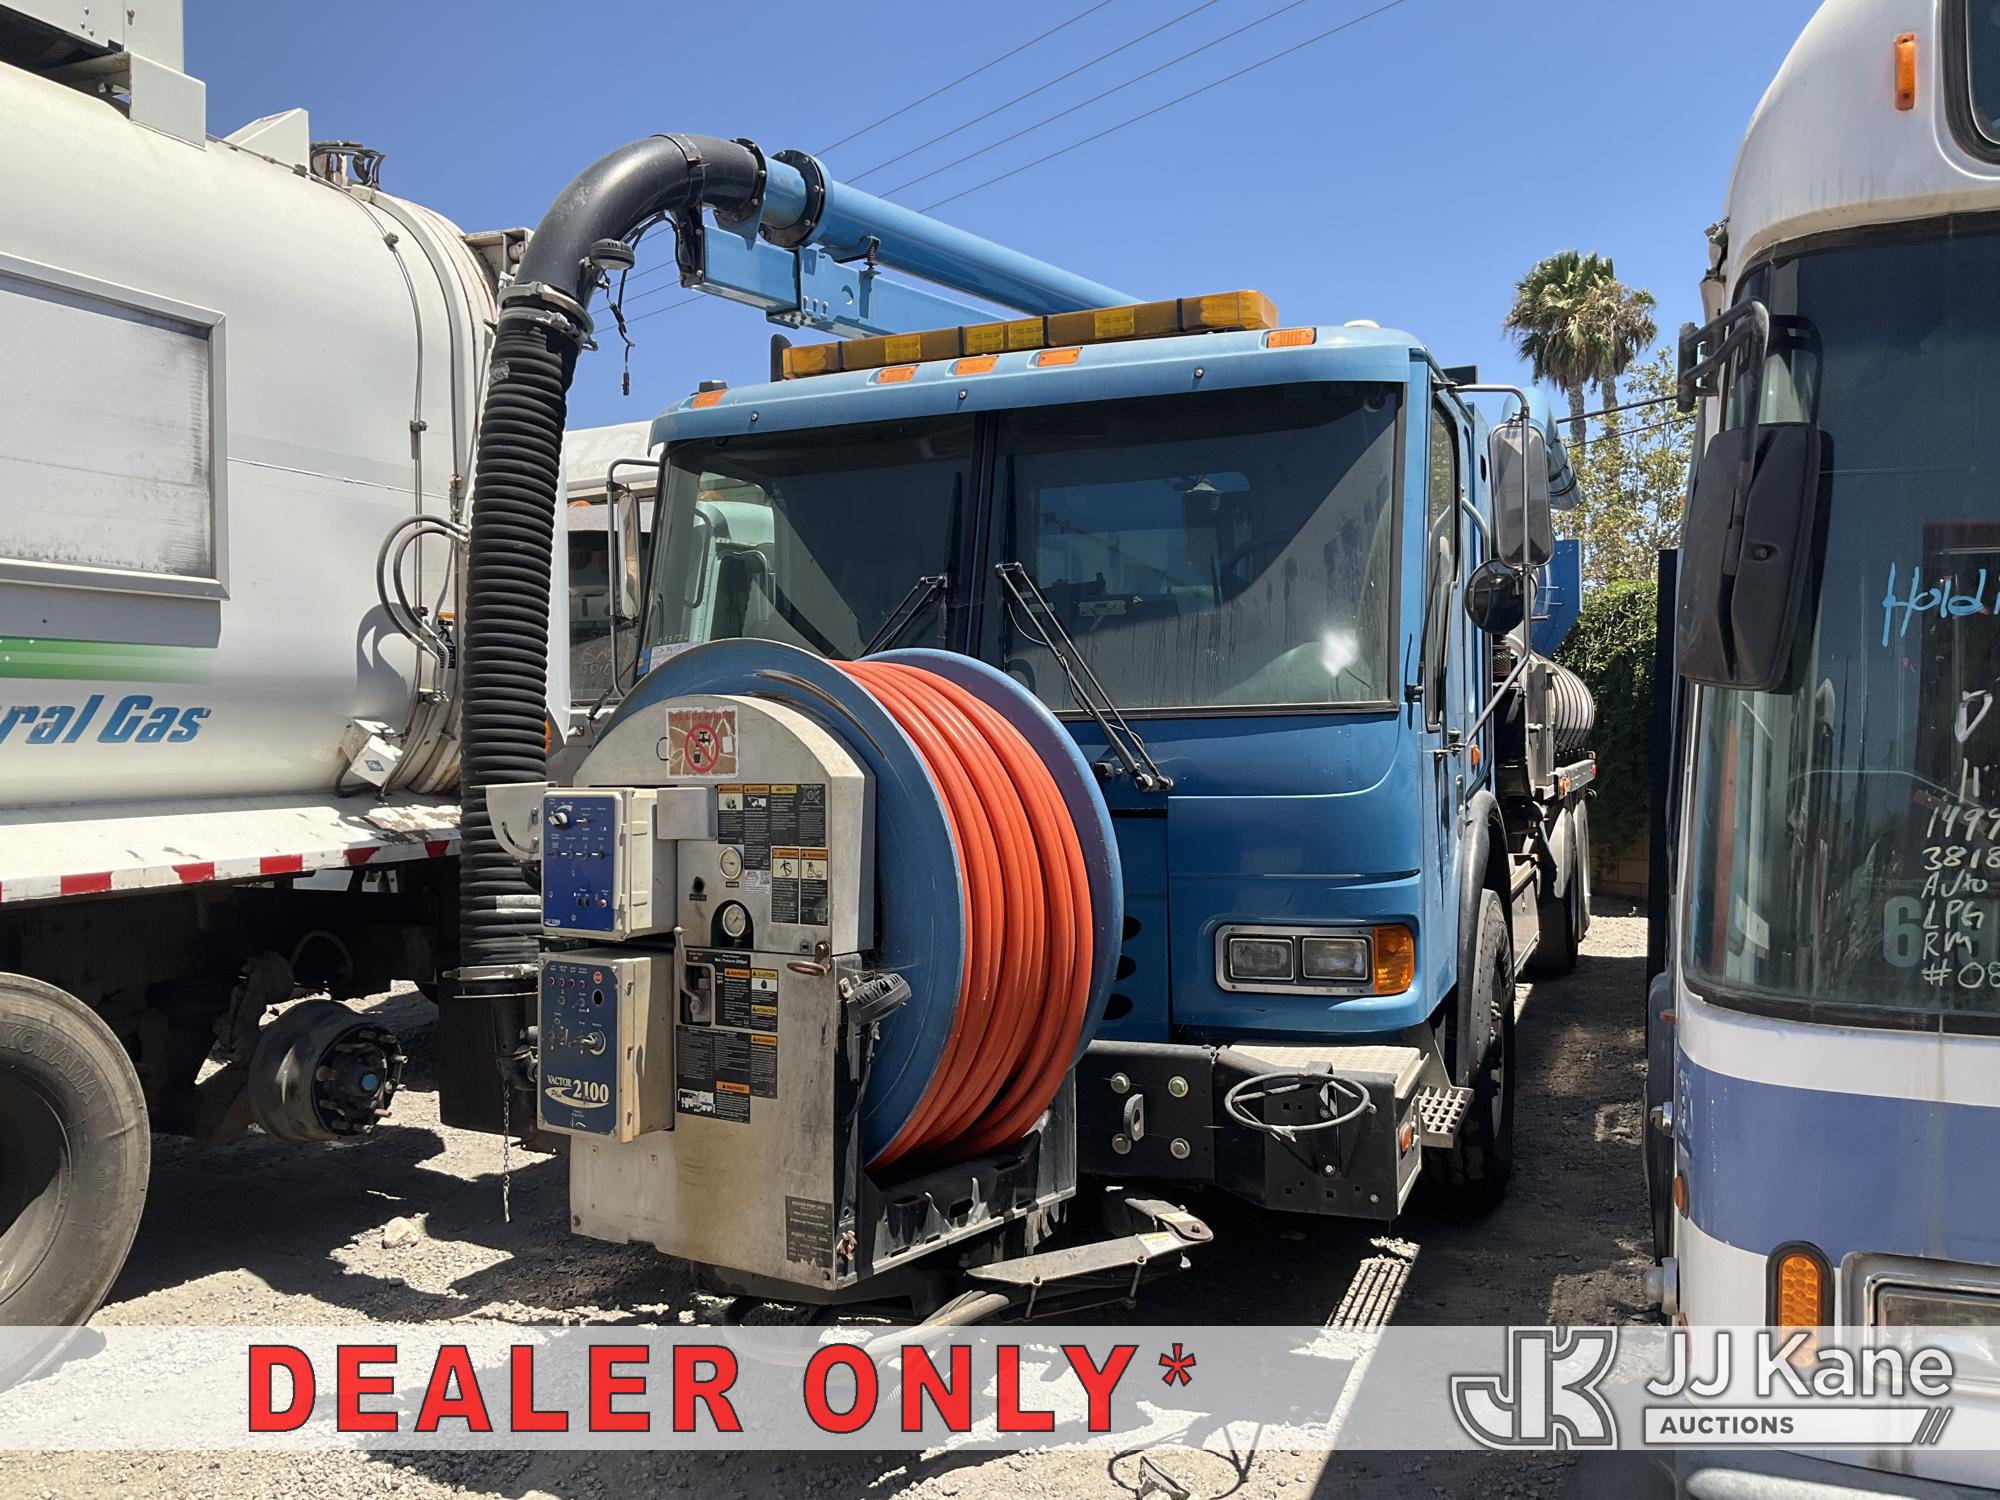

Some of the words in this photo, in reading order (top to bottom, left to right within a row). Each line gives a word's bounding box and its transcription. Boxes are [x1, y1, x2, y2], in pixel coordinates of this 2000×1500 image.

[97, 694, 212, 744] Gas
[1922, 899, 1985, 929] LPG
[547, 1074, 572, 1087] VACTOR
[572, 1079, 609, 1103] 2100
